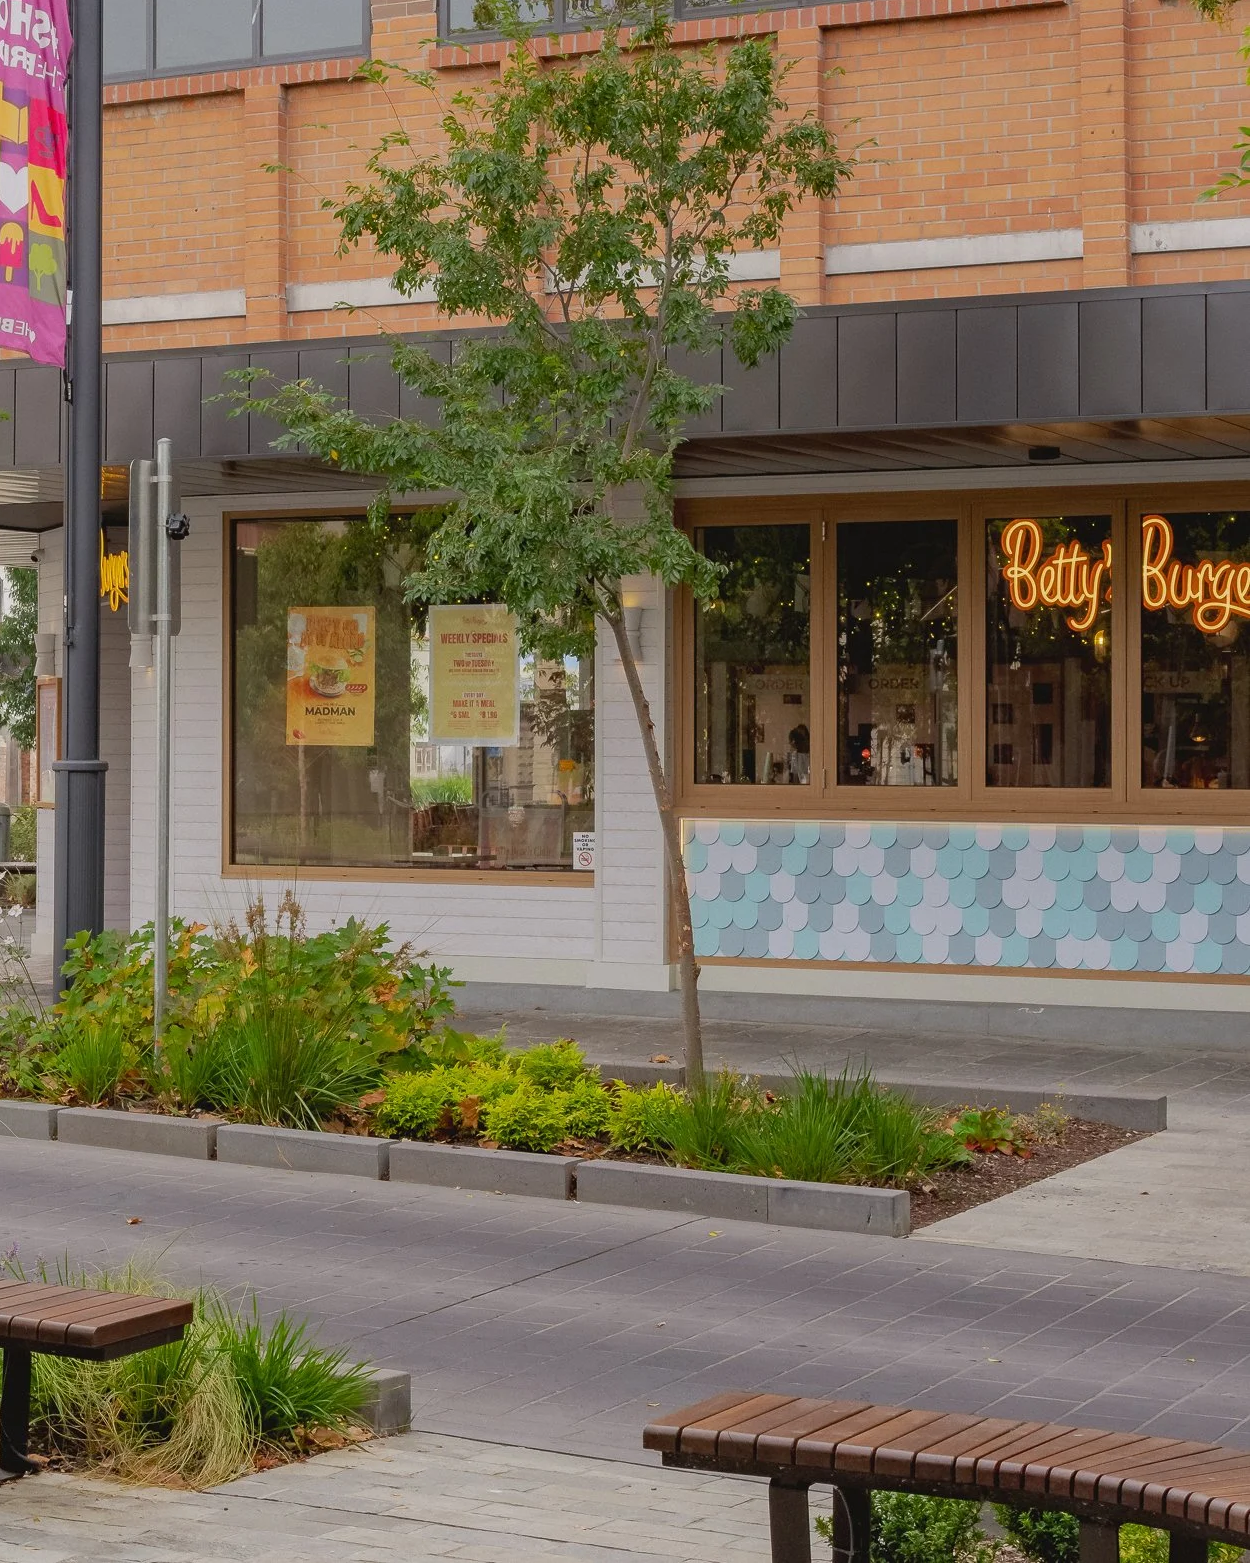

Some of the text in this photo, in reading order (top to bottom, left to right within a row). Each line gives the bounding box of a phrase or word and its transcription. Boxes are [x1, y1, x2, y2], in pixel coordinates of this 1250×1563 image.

[440, 632, 508, 644] WEEKLY SPECIALS
[453, 659, 465, 668] TWO
[757, 678, 804, 690] ORDER
[868, 677, 919, 690] ORDER
[452, 699, 469, 708] MAKE
[469, 699, 474, 708] IT
[480, 699, 495, 708] MEAL
[305, 706, 356, 716] MADMAN
